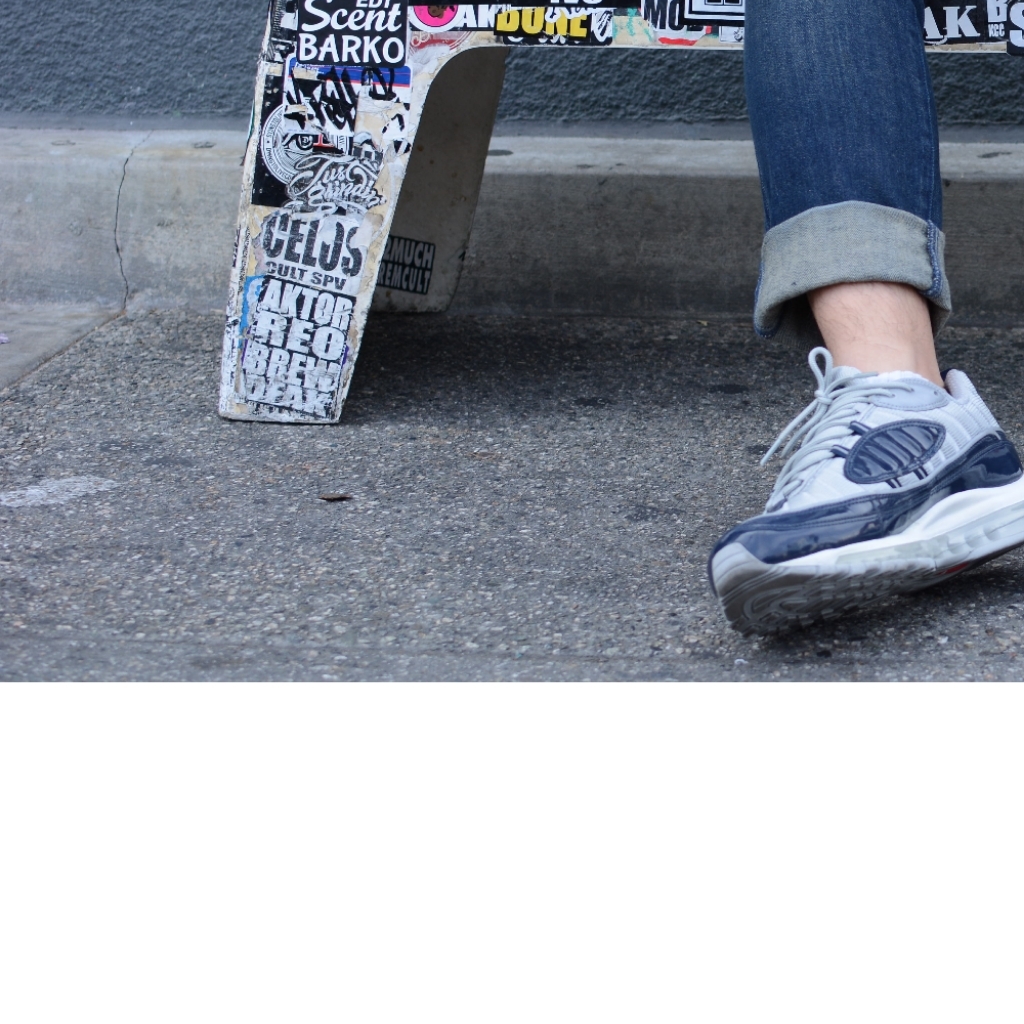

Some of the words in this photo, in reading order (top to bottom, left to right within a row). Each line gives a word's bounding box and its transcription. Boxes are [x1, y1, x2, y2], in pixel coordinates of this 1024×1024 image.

[298, 32, 405, 64] BARKO
[265, 261, 308, 281] CULT
[311, 272, 347, 291] SPV
[258, 278, 353, 331] AKTOR
[254, 312, 346, 361] REO
